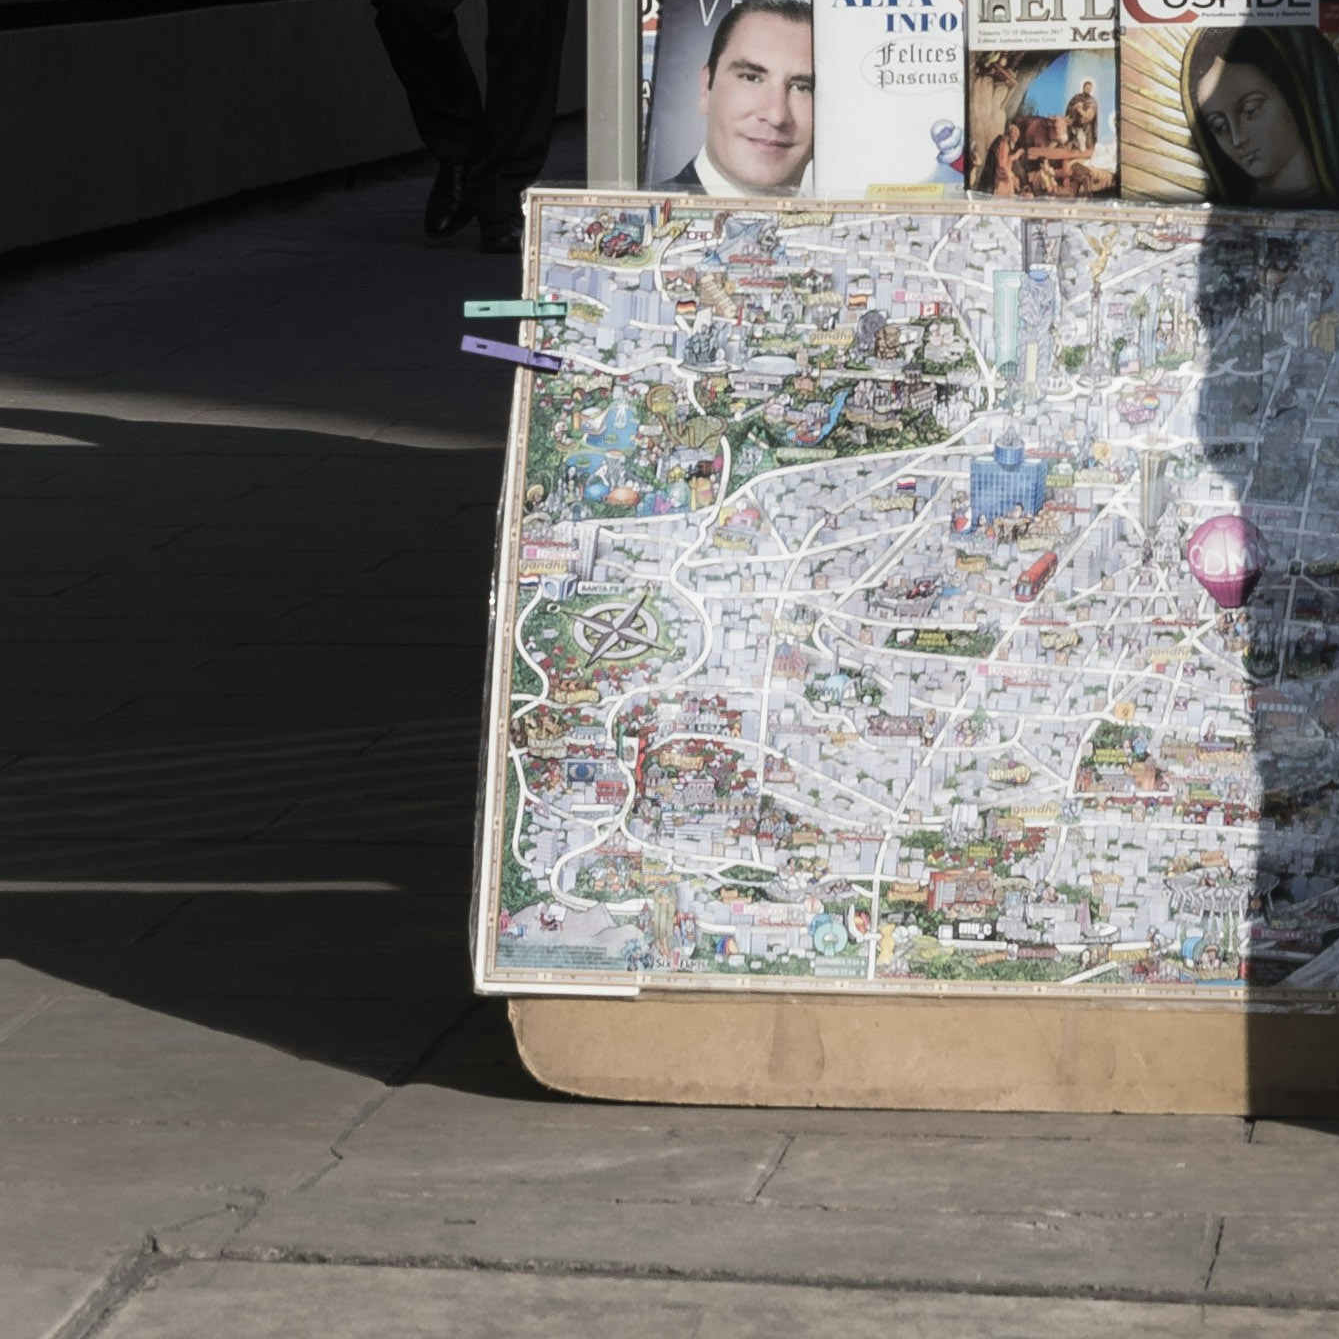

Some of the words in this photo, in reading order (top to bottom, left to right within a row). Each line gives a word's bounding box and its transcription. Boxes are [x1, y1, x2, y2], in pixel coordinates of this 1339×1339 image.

[874, 42, 957, 68] Felices
[877, 70, 959, 88] Pascuas
[809, 331, 854, 344] gandhi
[521, 560, 569, 571] gandhi
[1013, 803, 1057, 815] gandhi
